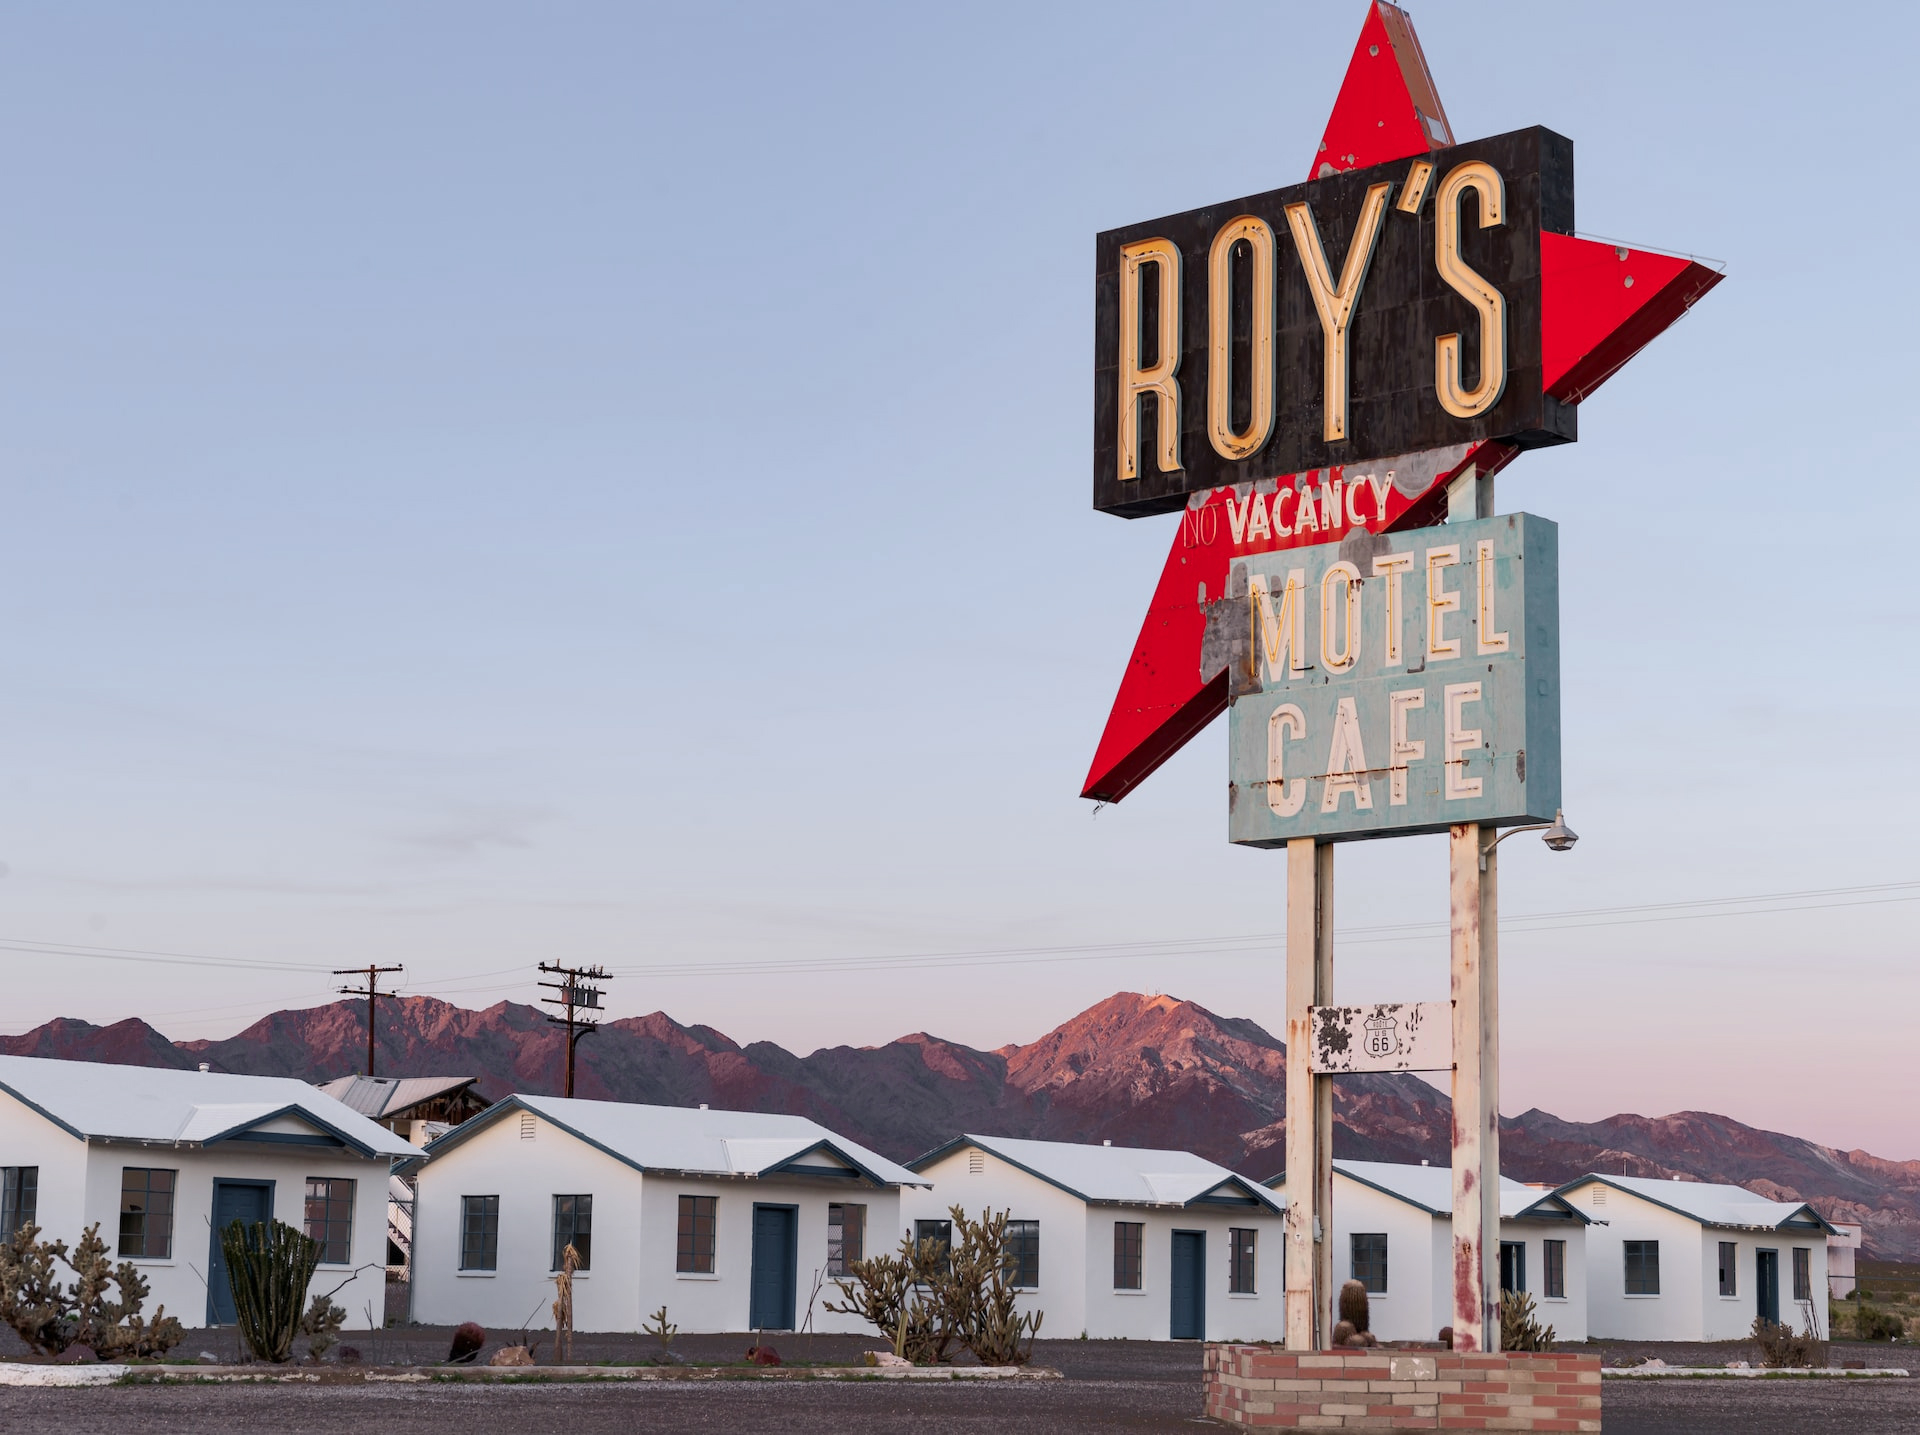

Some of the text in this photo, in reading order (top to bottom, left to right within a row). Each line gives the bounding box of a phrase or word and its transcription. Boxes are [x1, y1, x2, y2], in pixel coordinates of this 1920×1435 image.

[1117, 159, 1506, 481] ROY'S
[1183, 470, 1395, 548] NO VACANCY
[1248, 539, 1509, 682] MOTEL
[1267, 681, 1483, 817] CAFE
[1372, 1037, 1389, 1051] 66
